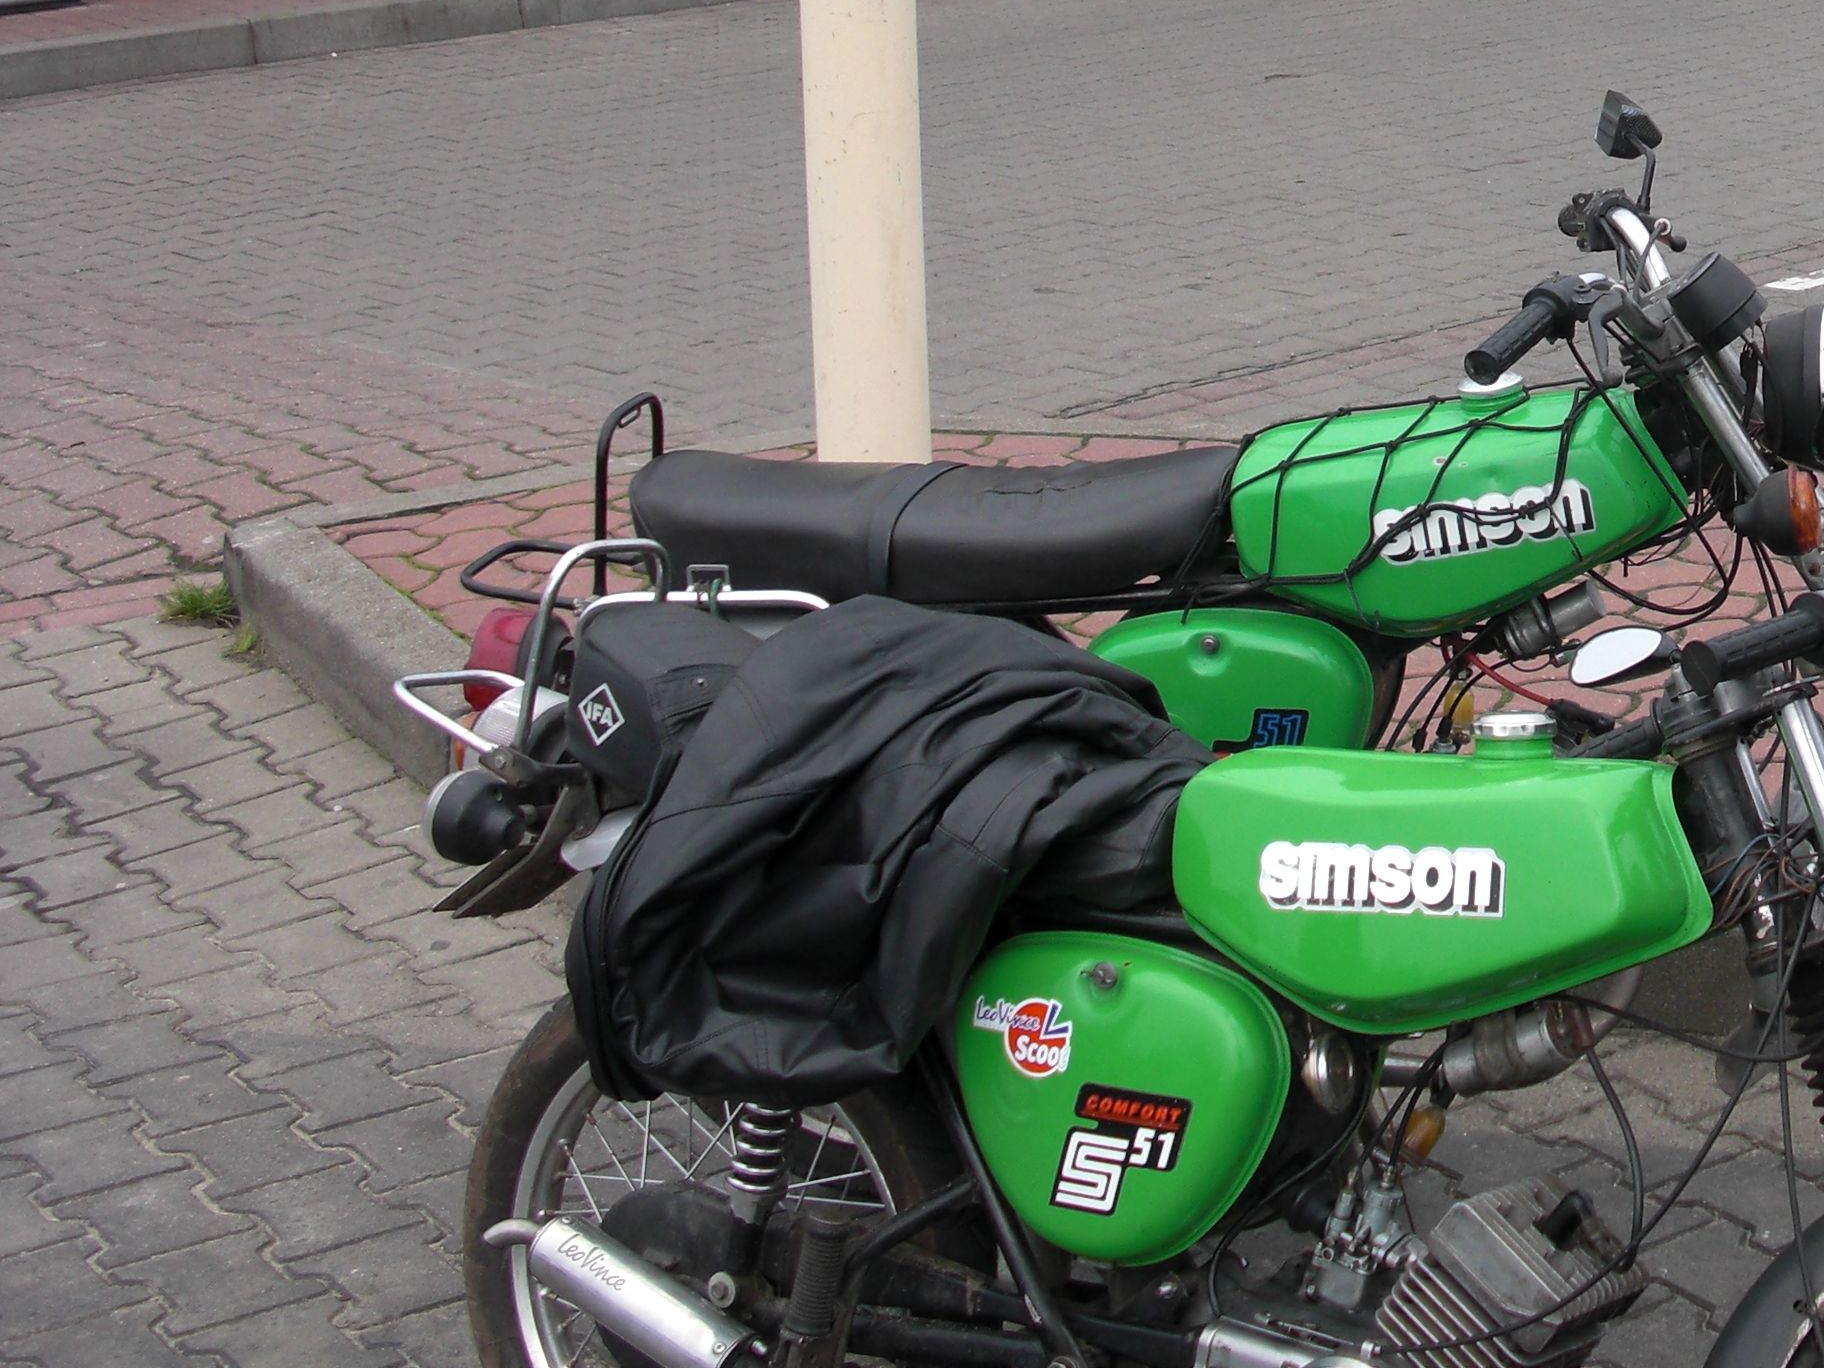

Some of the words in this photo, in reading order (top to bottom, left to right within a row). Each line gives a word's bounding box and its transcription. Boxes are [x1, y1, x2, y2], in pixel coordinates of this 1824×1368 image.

[586, 701, 613, 727] IFA
[1253, 713, 1302, 748] 51
[975, 995, 1041, 1032] LeoVince
[1086, 1094, 1184, 1124] COMFORT
[557, 1233, 626, 1292] LeoVince
